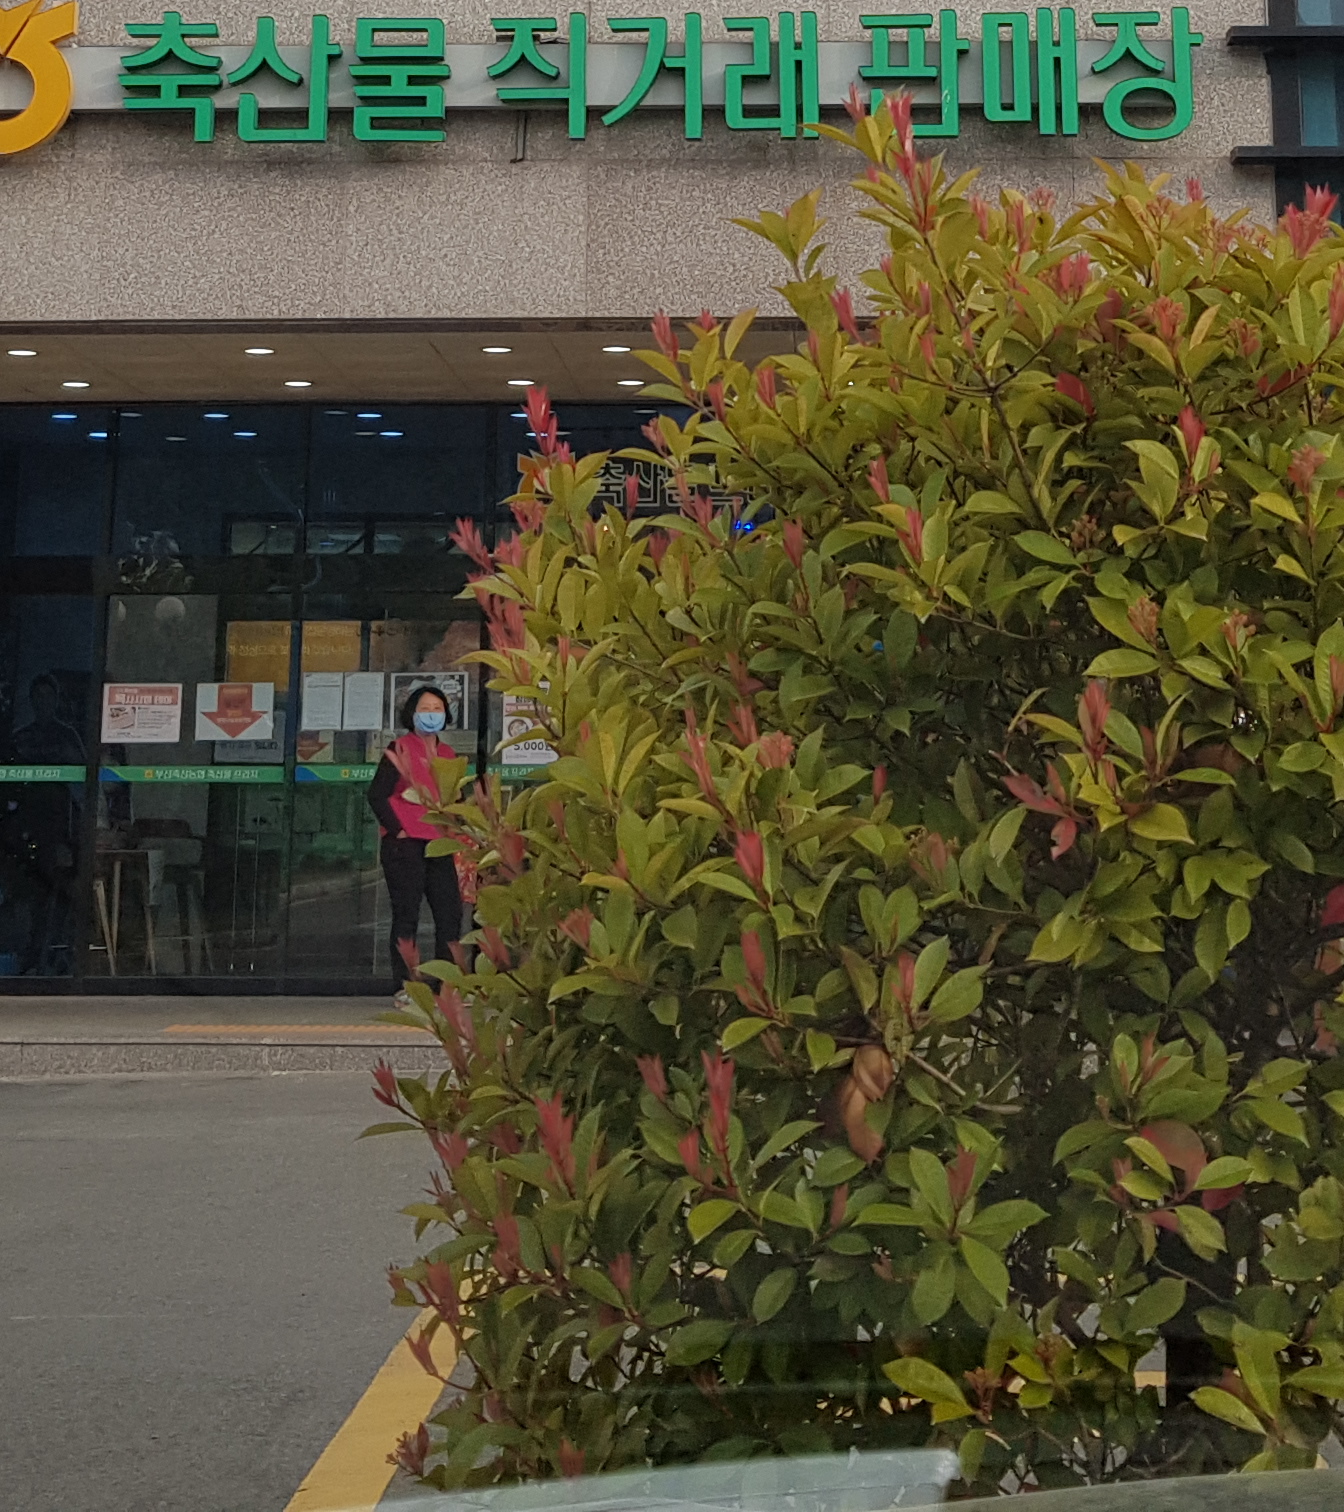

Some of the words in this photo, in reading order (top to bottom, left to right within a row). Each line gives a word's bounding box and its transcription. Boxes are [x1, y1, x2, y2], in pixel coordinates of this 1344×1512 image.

[118, 11, 451, 143] 축산물
[486, 10, 820, 143] 직거래
[858, 7, 1204, 141] 판매장
